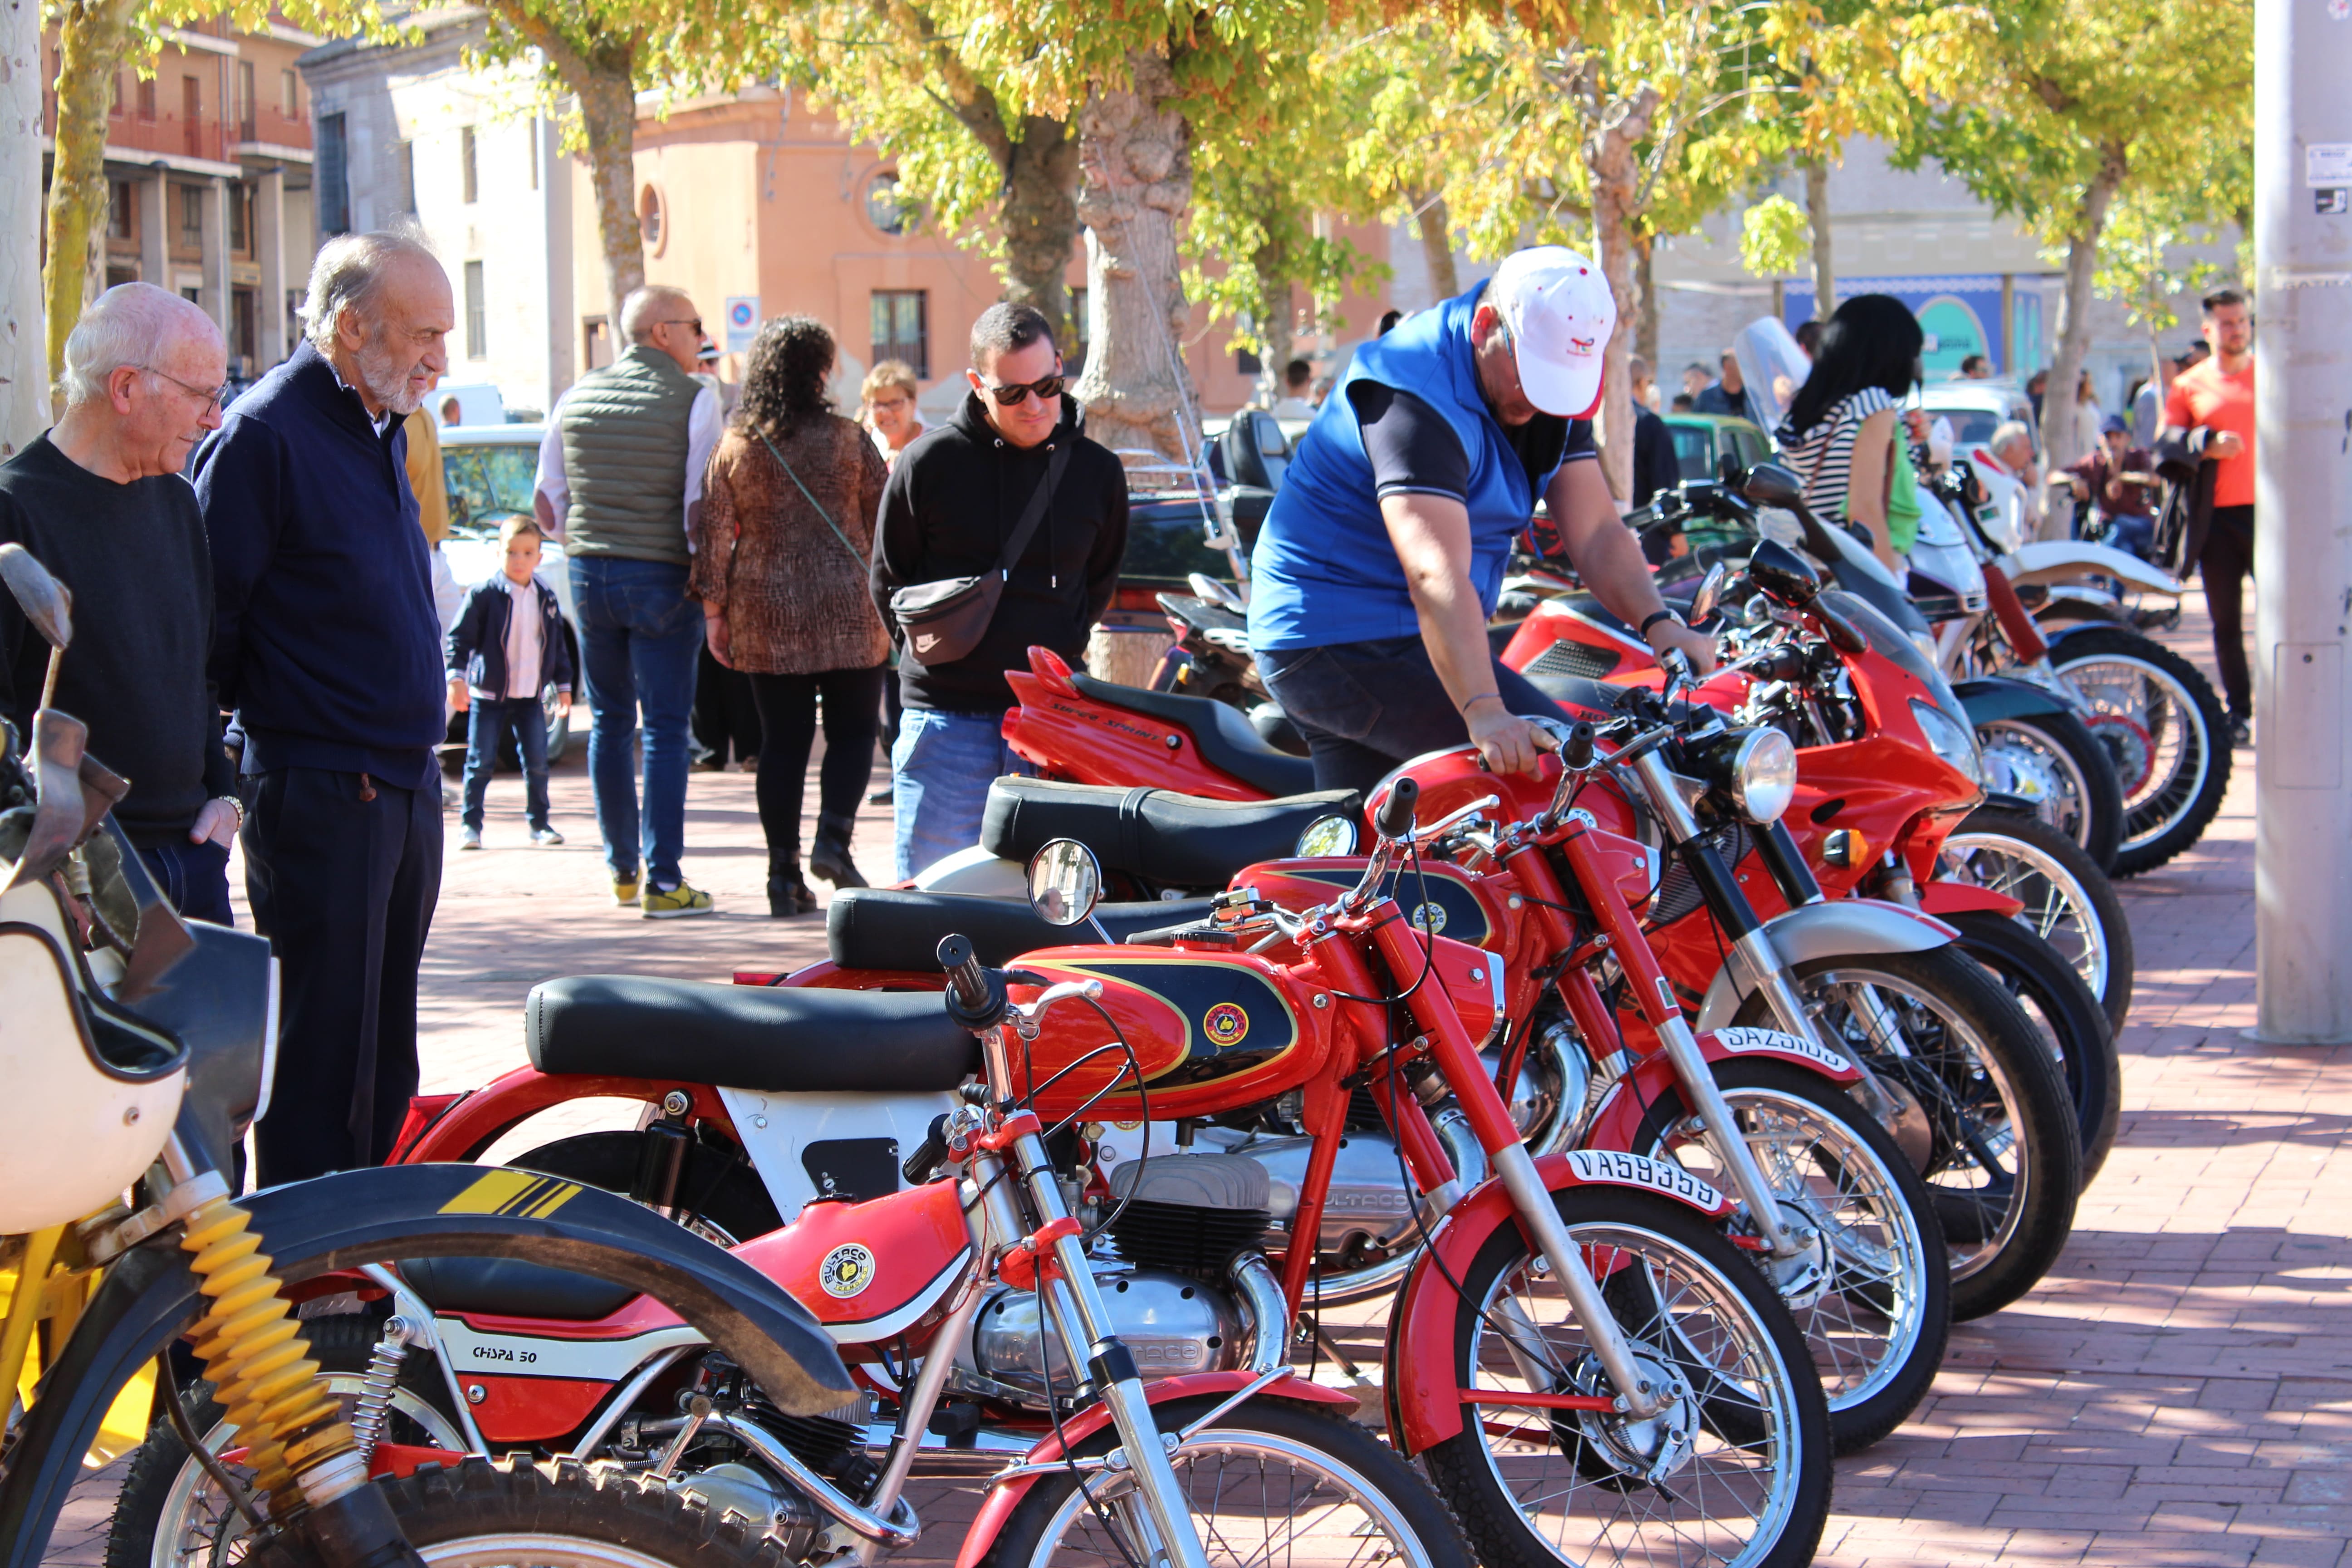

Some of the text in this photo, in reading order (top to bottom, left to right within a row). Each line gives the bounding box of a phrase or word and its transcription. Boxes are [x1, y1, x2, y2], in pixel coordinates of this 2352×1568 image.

[1207, 1006, 1245, 1030] BULTACO
[1572, 1152, 1713, 1205] VA59359
[1324, 1193, 1407, 1206] ULTACO
[824, 1248, 867, 1284] BULTACO
[519, 1351, 537, 1363] 50
